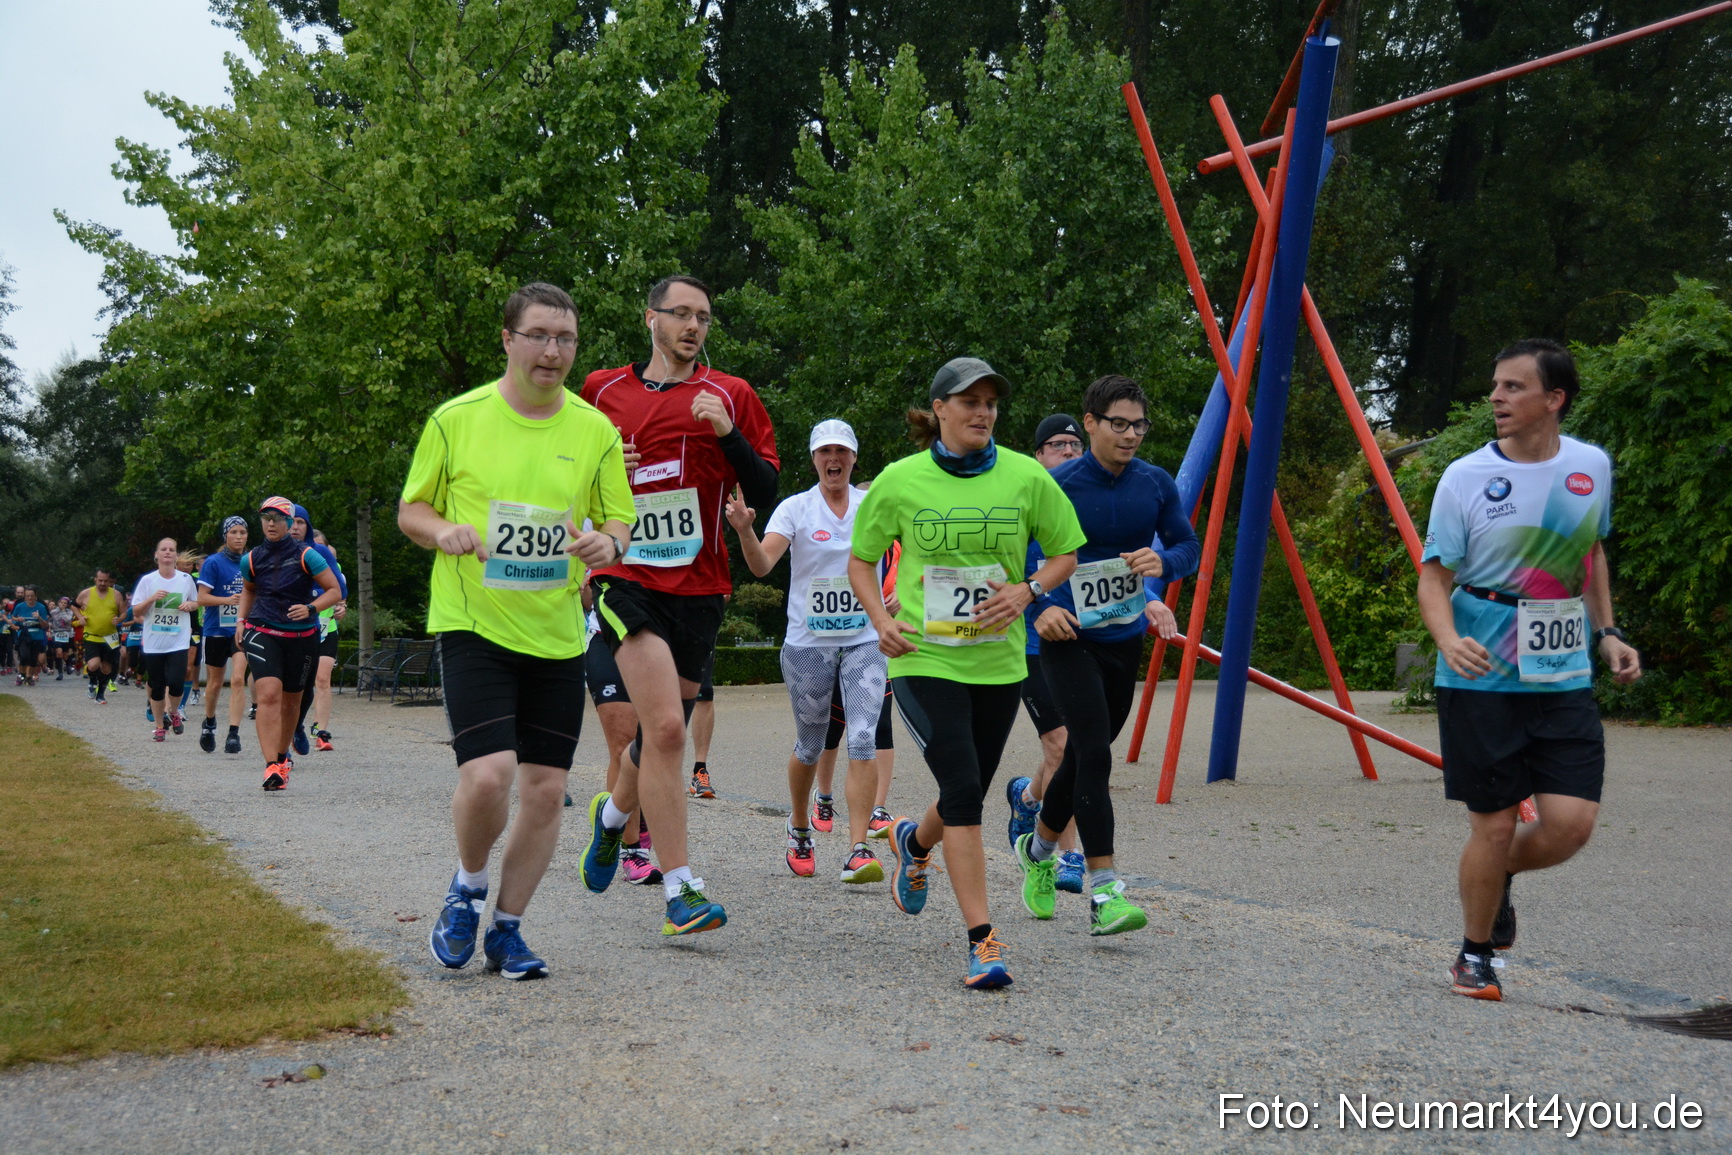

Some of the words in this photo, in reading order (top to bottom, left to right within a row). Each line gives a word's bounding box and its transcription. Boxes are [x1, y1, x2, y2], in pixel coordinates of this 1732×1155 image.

[647, 467, 668, 477] DEHN
[1486, 502, 1516, 515] PARTL
[1487, 509, 1517, 520] Neumarkt
[631, 508, 694, 541] 2018
[913, 507, 1020, 551] OPF
[496, 523, 566, 557] 2392
[639, 546, 687, 559] Christian
[504, 564, 554, 579] Christian
[1081, 573, 1137, 607] 2033
[812, 590, 864, 613] 3092
[154, 614, 179, 625] 2434
[1101, 604, 1131, 620] Patrick
[808, 616, 866, 631] ANDREA
[955, 625, 982, 637] Petr
[1528, 616, 1582, 651] 3082
